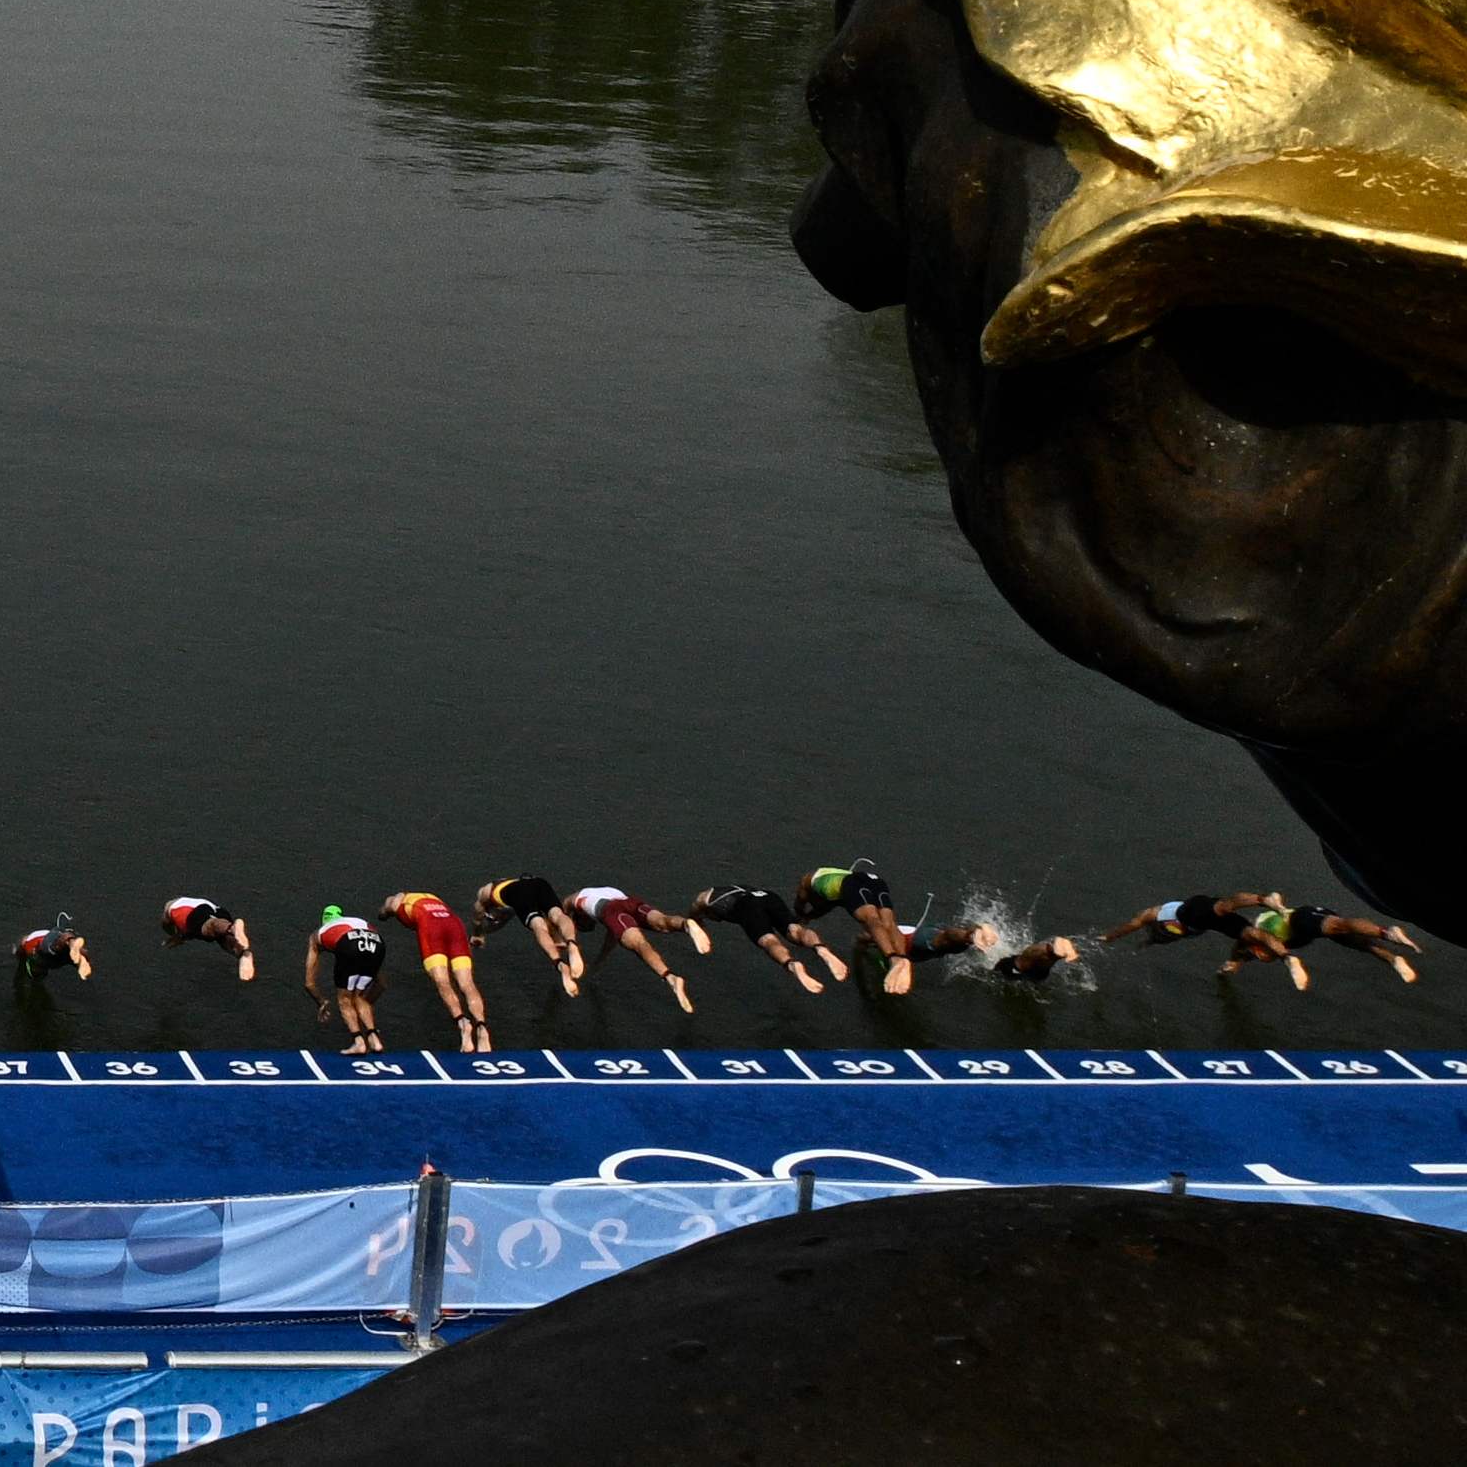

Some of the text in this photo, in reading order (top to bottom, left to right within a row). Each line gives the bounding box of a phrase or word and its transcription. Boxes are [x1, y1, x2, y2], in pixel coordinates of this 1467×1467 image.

[105, 1061, 159, 1076] 36
[228, 1060, 281, 1076] 35
[351, 1060, 405, 1076] 34
[471, 1060, 526, 1075] 33
[594, 1059, 650, 1075] 32
[721, 1059, 767, 1075] 31
[832, 1059, 896, 1075] 30
[958, 1059, 1011, 1075] 29
[1079, 1060, 1136, 1075] 28
[1202, 1060, 1252, 1075] 27
[1321, 1059, 1379, 1075] 26
